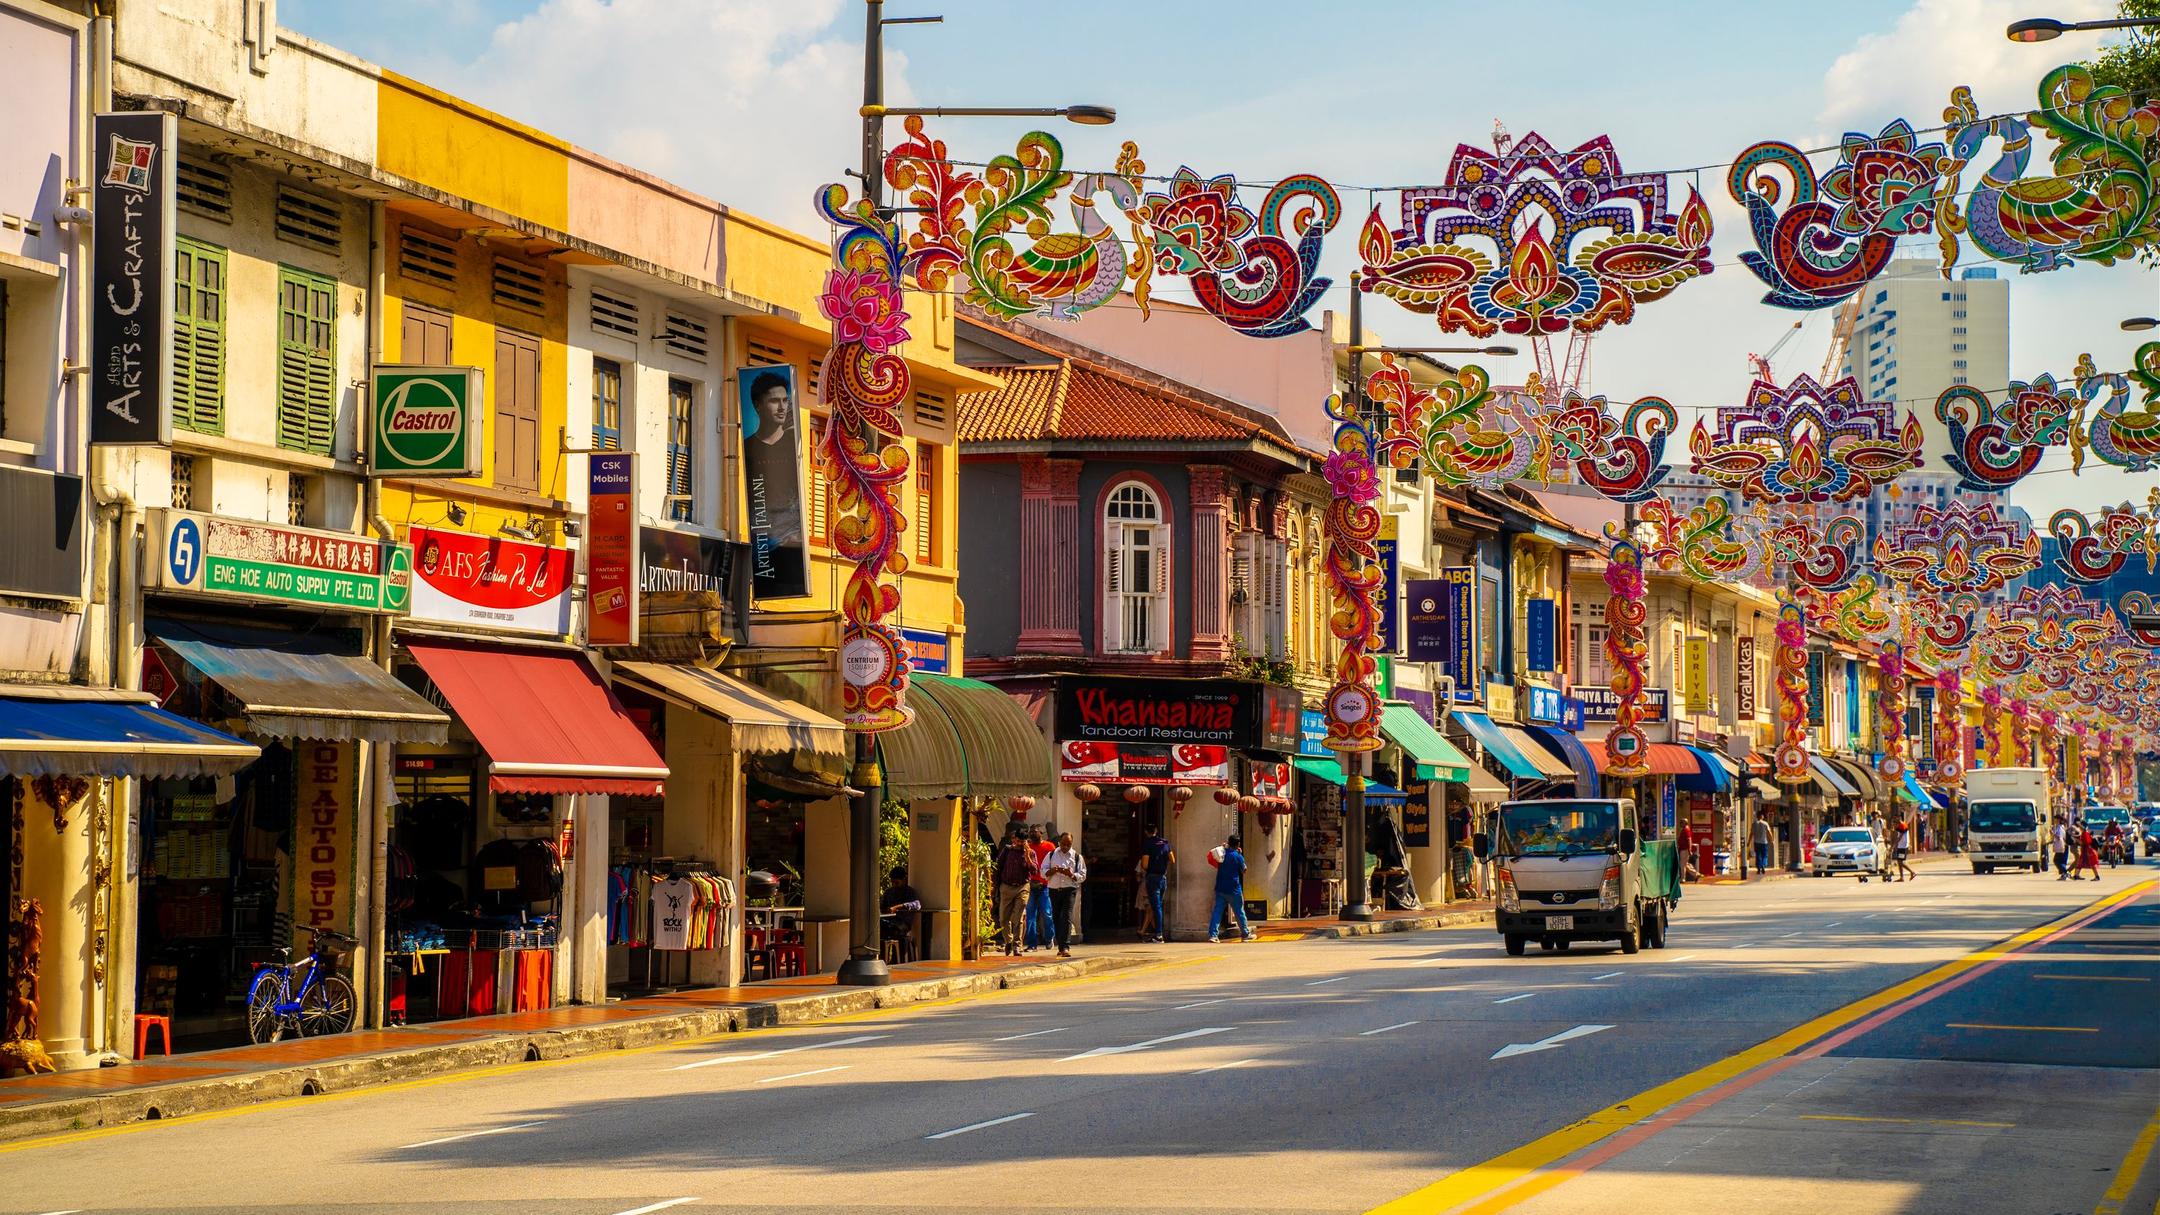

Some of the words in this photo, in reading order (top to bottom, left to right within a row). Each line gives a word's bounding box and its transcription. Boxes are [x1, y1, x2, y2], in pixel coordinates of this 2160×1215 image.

[124, 320, 141, 336] &
[393, 410, 456, 431] Castrol
[601, 461, 621, 470] CSK
[593, 474, 629, 483] Mobiles
[440, 550, 474, 579] AFS
[471, 550, 508, 588] Fashion
[526, 560, 548, 598] Ltd
[1443, 570, 1471, 584] ABC
[213, 564, 236, 585] ENG
[240, 567, 261, 588] HOE
[265, 571, 292, 592] AUTO
[296, 575, 330, 596] SUPPLY
[334, 579, 354, 599] PTE.
[357, 582, 375, 601] LTD.
[1692, 644, 1700, 699] SURIYA
[1076, 687, 1234, 730] Khansama
[1340, 703, 1362, 713] Singtel
[1080, 724, 1147, 738] Tandoori
[1151, 727, 1234, 740] Restaurant
[311, 790, 338, 864] AUTO
[663, 918, 682, 926] ROCK
